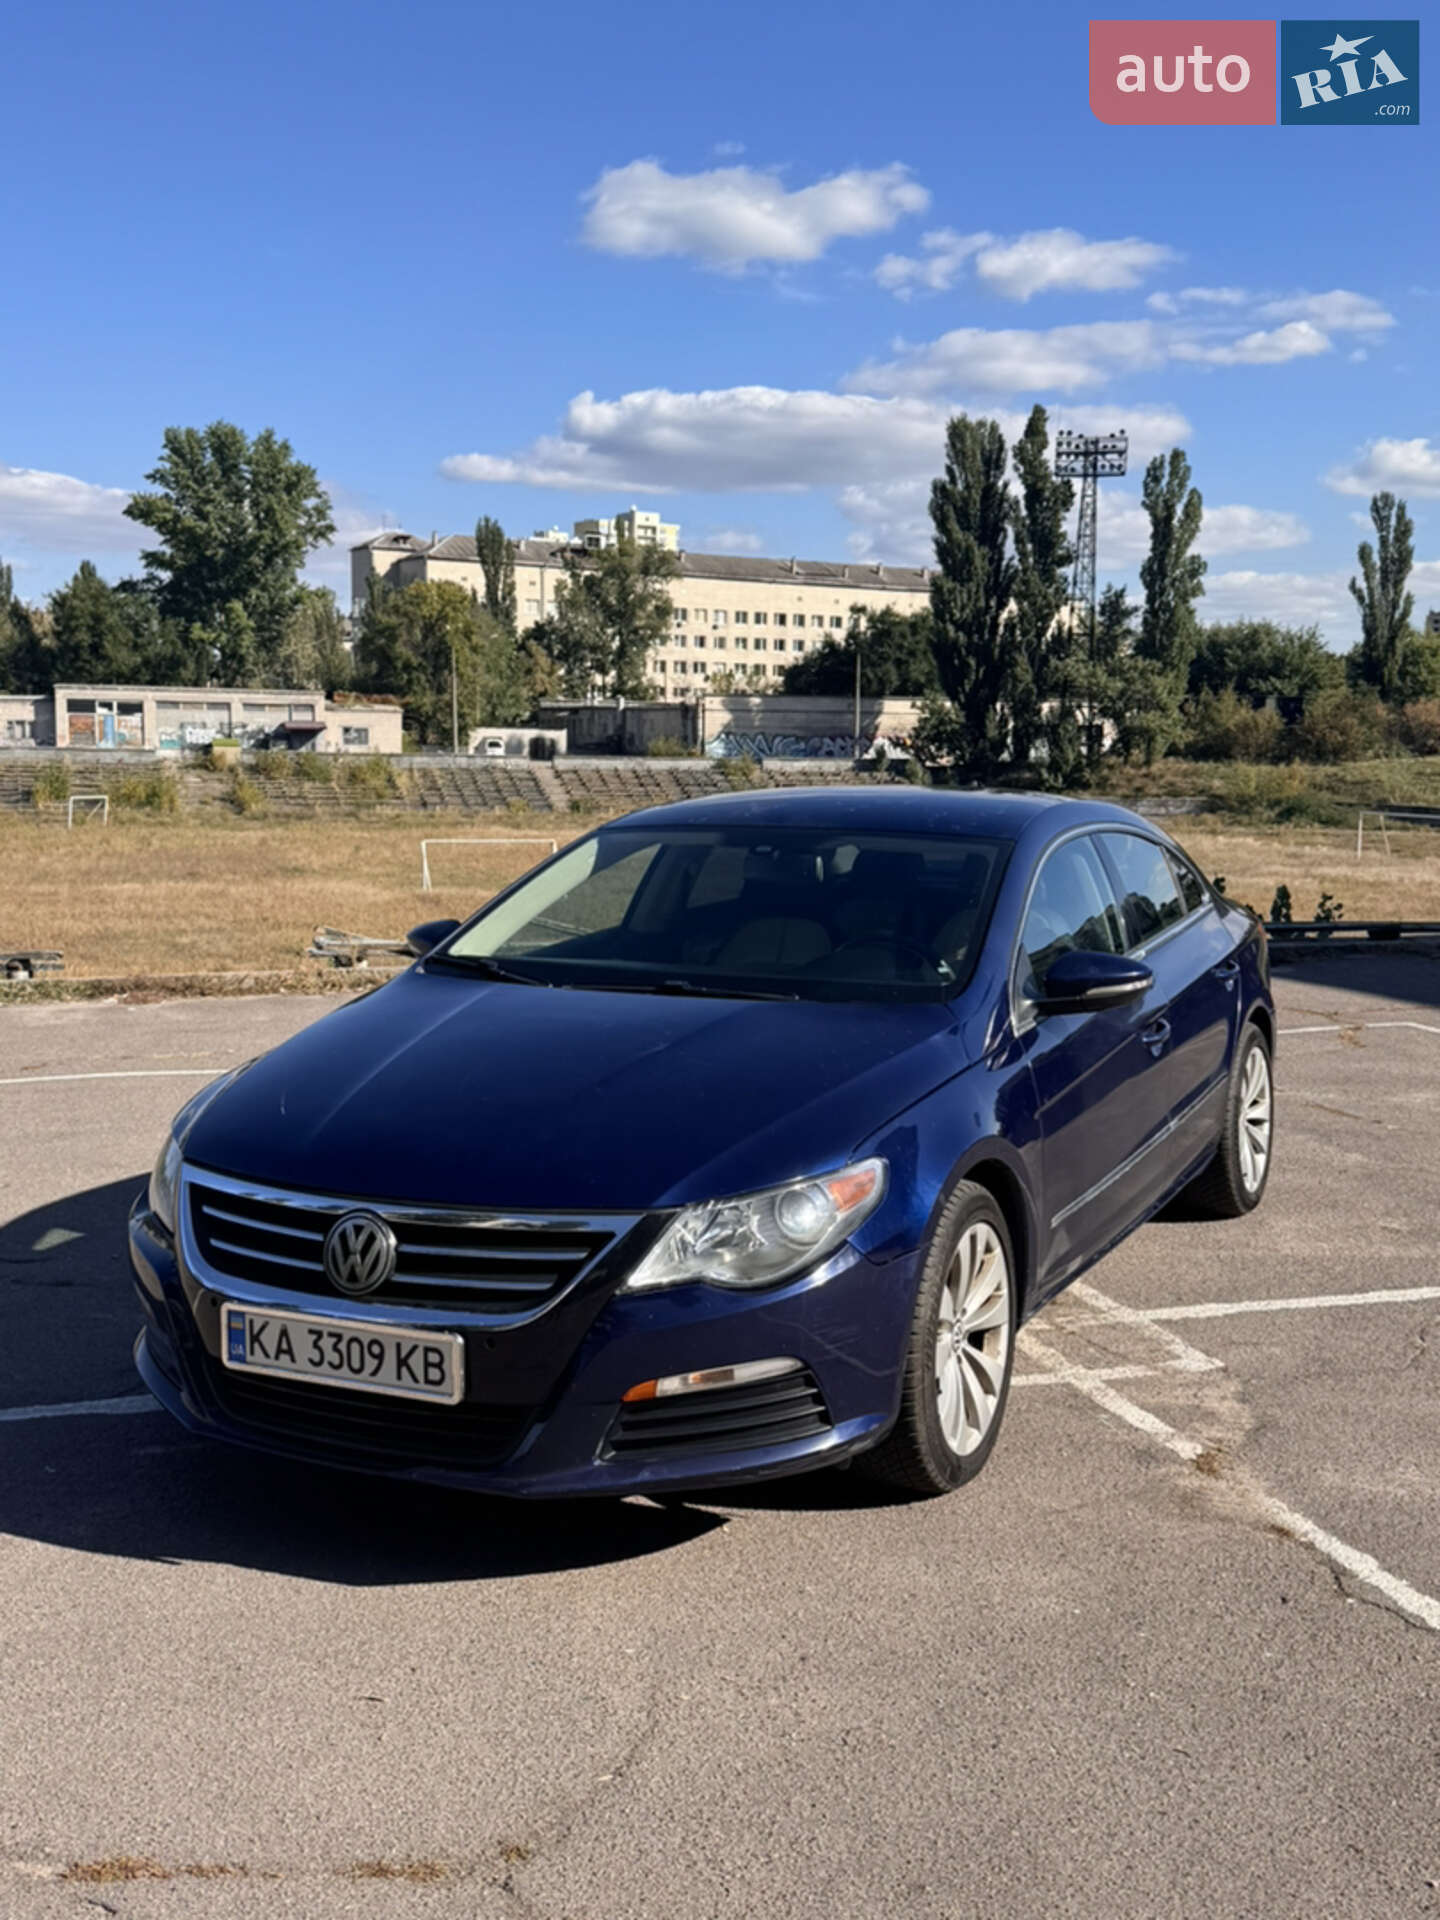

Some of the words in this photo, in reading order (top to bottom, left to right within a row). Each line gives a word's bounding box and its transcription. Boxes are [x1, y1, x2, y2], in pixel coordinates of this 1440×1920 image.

[249, 1318, 297, 1365] KA
[307, 1328, 386, 1378] 3309
[395, 1341, 447, 1387] KB
